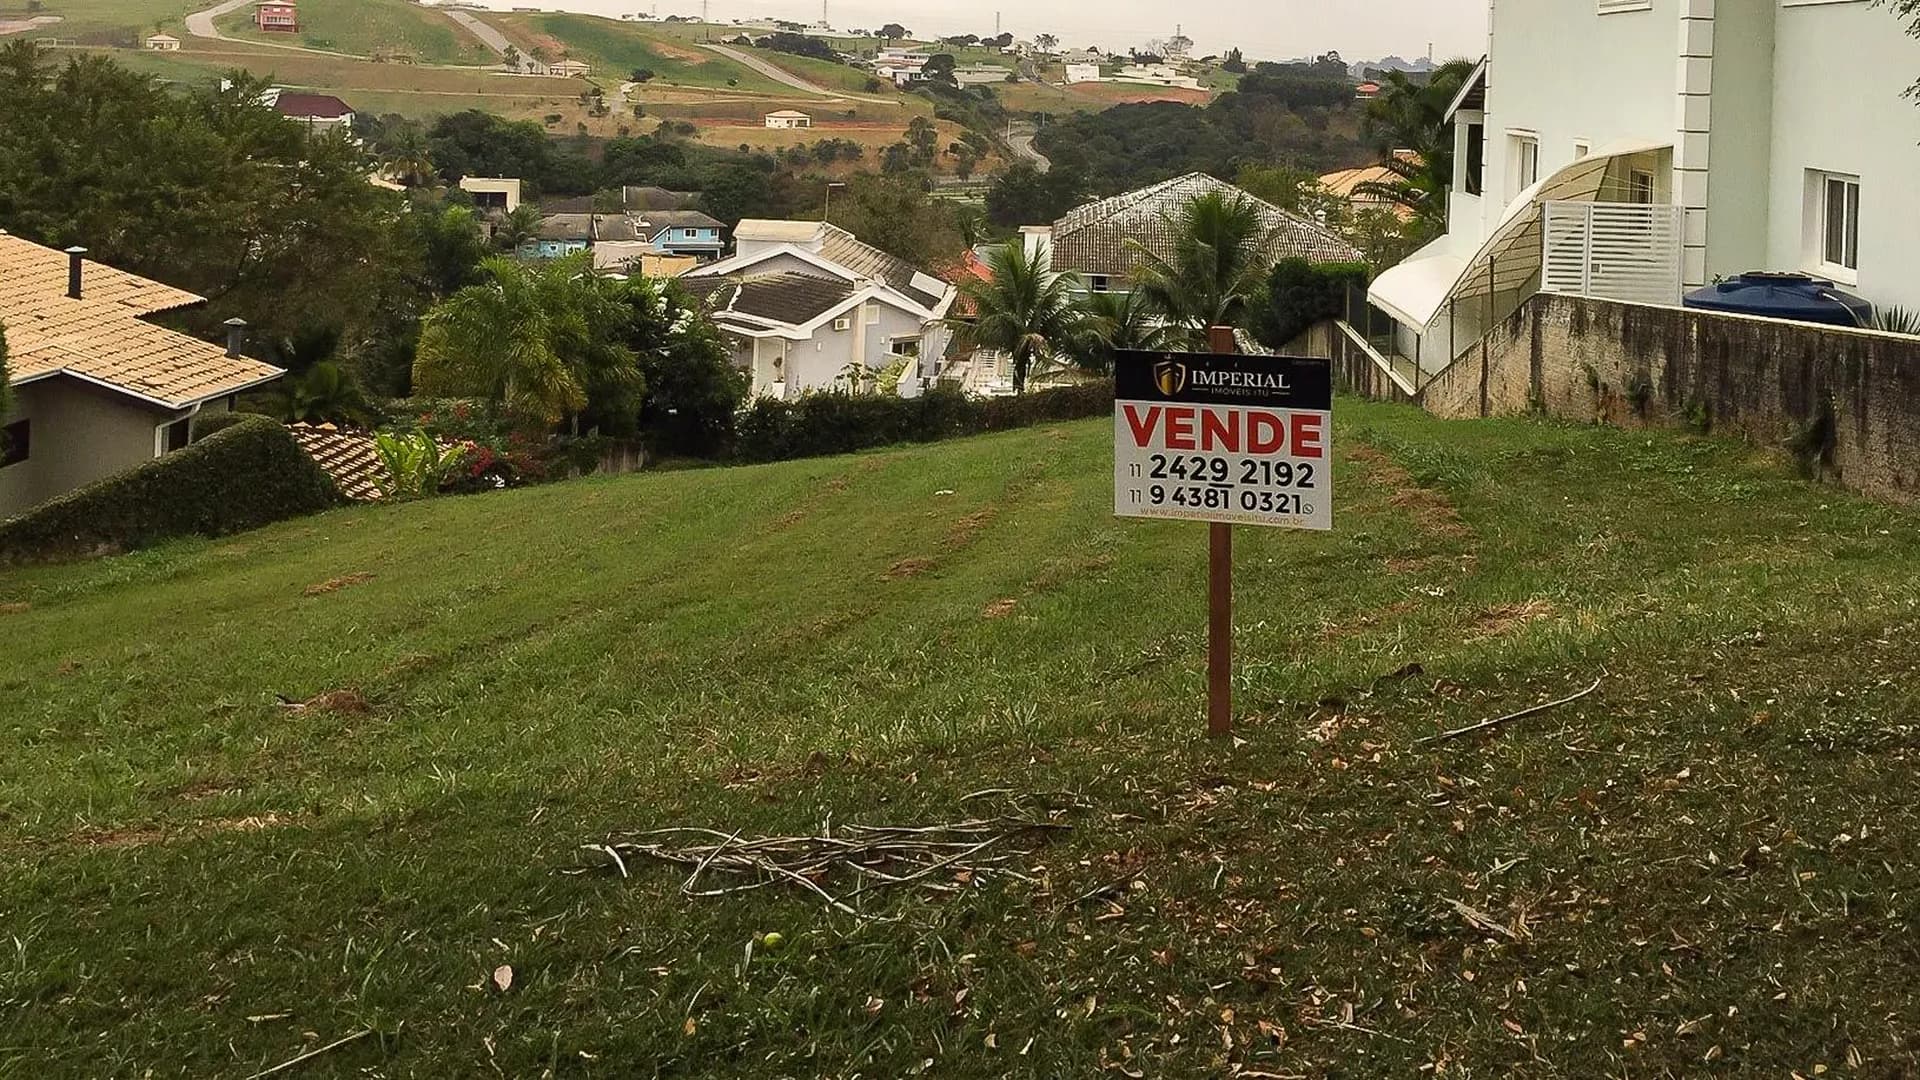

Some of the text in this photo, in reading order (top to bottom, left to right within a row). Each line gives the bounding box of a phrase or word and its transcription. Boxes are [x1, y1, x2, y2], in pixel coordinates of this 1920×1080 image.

[1192, 370, 1291, 389] IMPERIAL
[1123, 405, 1323, 458] VENDE
[1129, 454, 1315, 488] 11 2429 2192
[1129, 485, 1301, 514] 11 9 4381 0321
